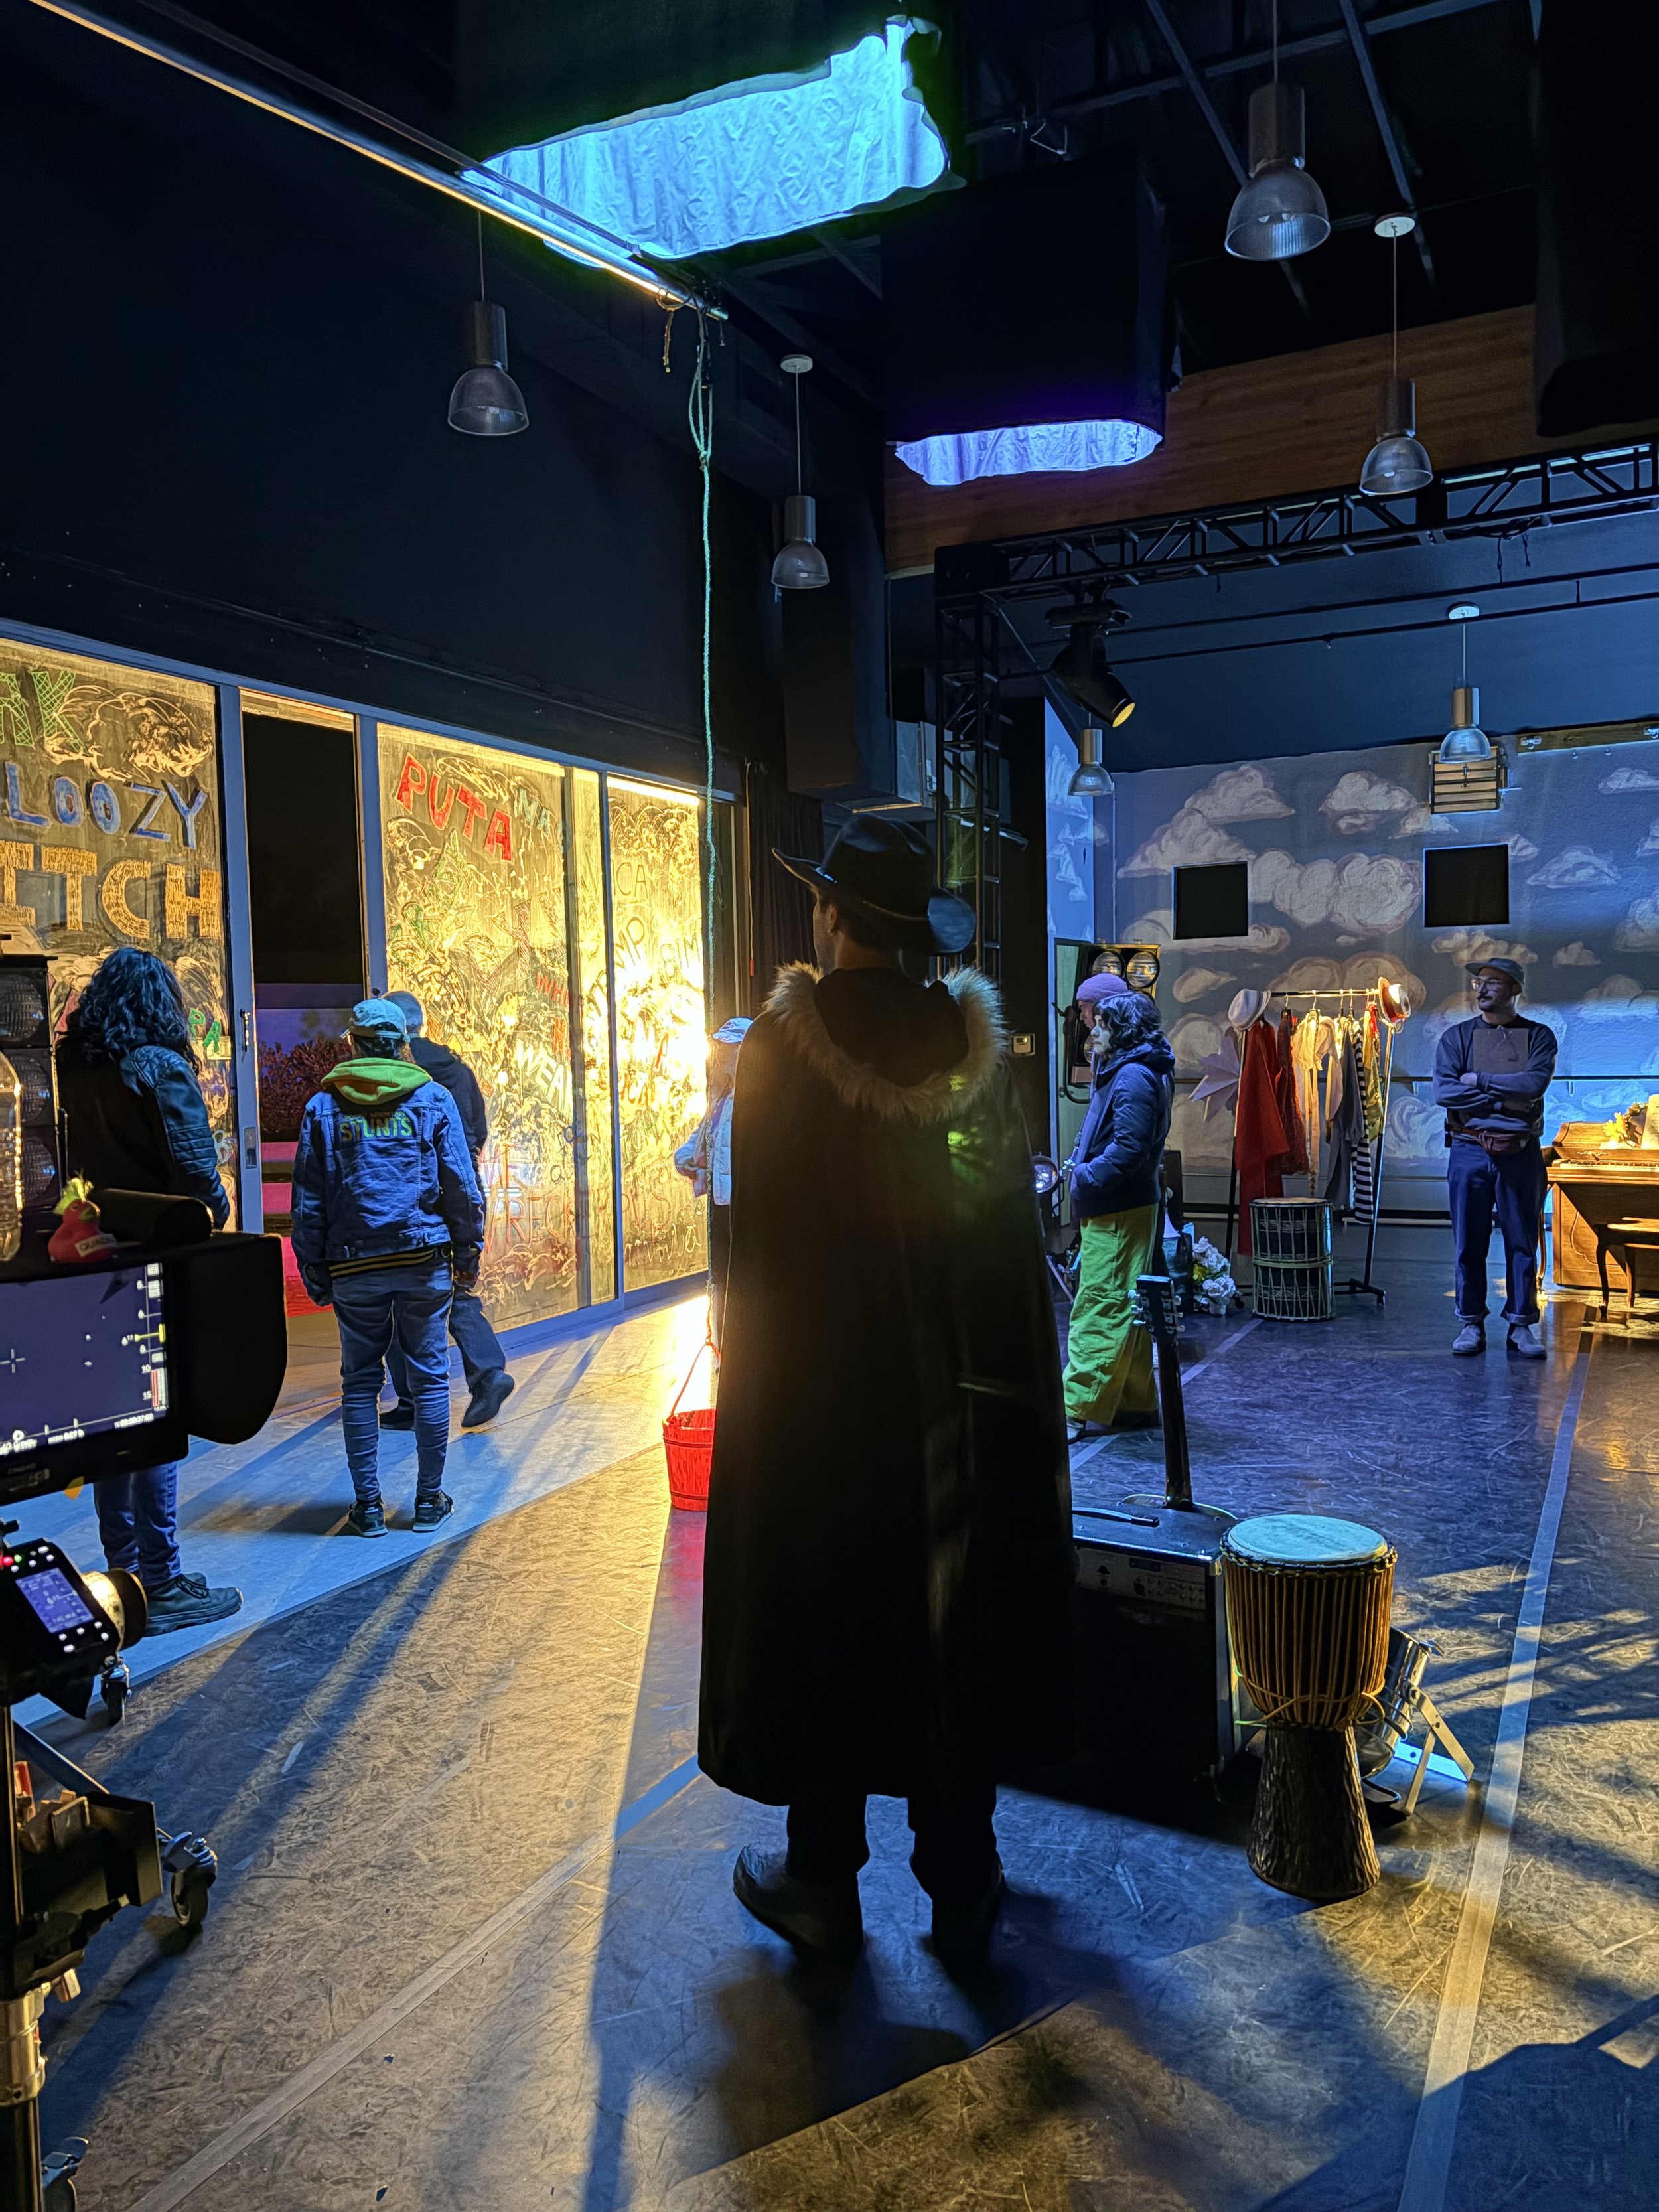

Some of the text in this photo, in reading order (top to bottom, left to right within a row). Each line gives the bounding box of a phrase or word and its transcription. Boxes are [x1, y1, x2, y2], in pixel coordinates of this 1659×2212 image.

[5, 761, 208, 849] LOOZY
[394, 752, 513, 865] PUTA
[339, 1116, 413, 1142] STUNTS
[143, 1390, 152, 1401] 15
